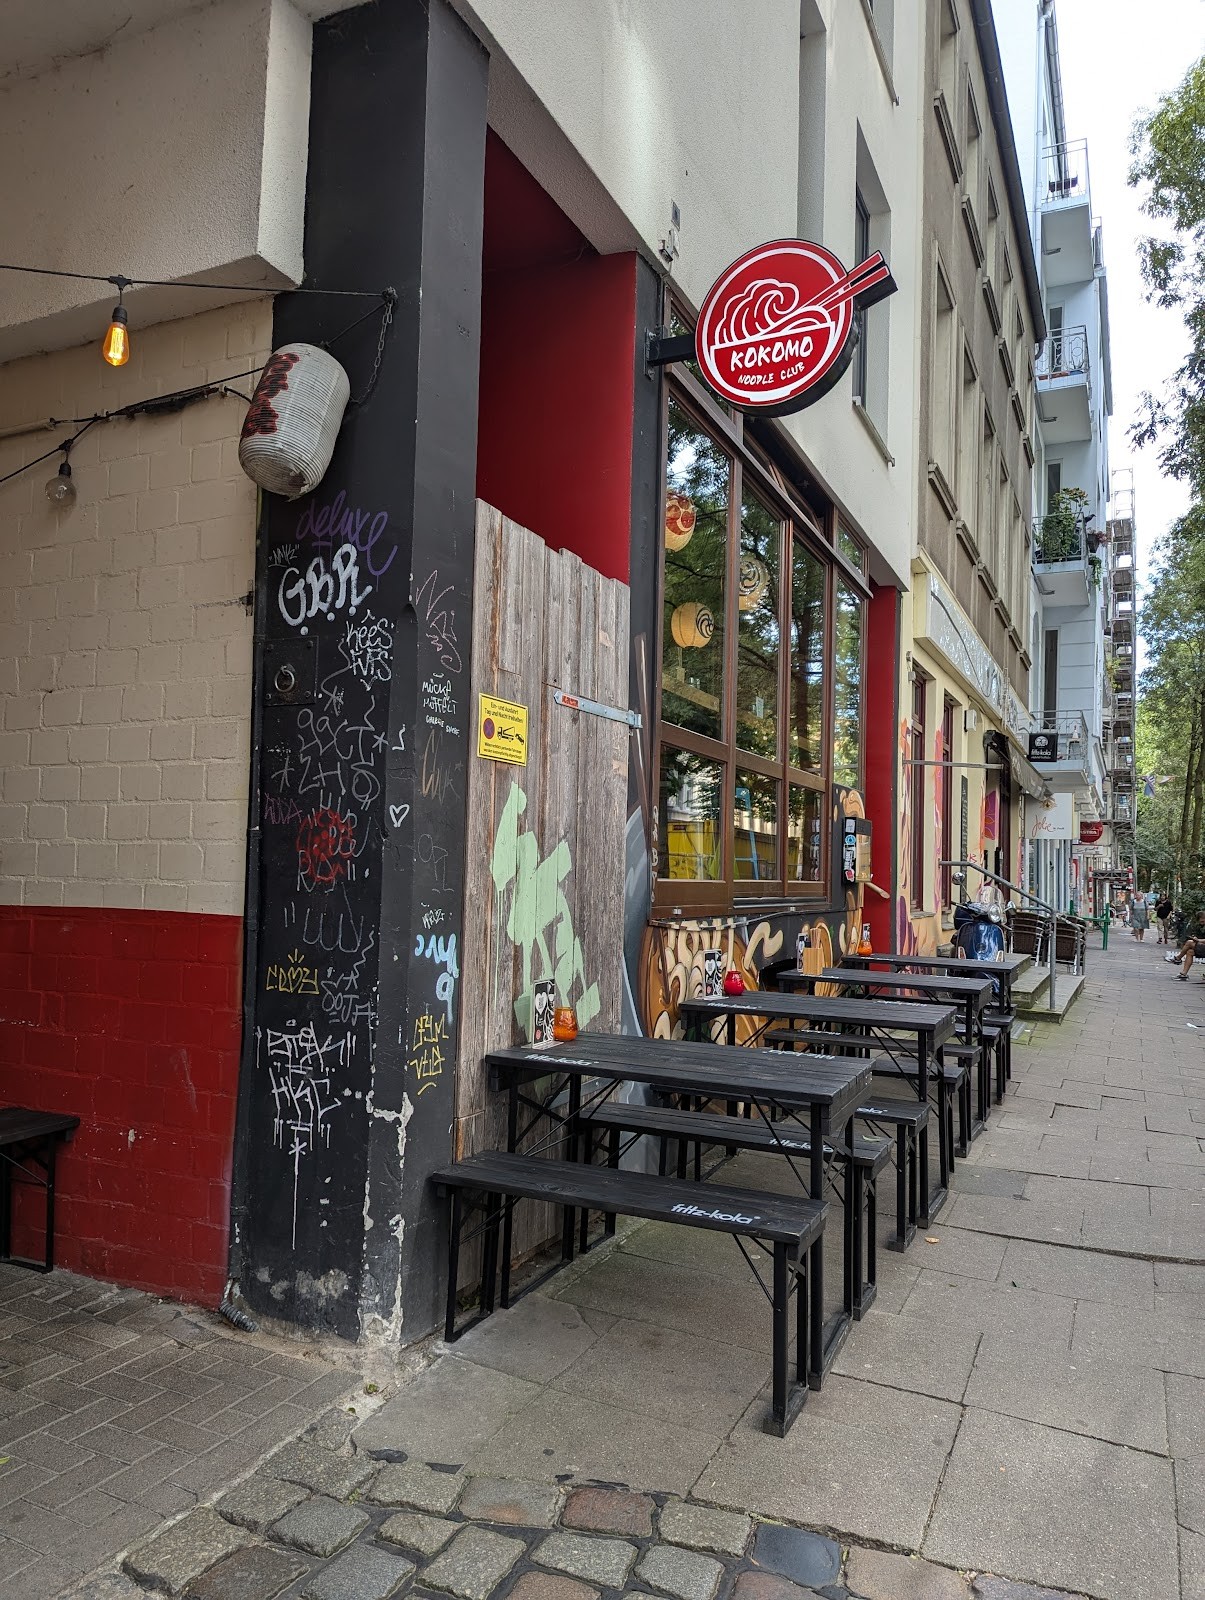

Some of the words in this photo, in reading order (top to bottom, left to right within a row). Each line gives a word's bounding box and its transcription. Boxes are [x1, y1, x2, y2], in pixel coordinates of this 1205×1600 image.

[730, 335, 814, 372] KOKOMO
[737, 373, 775, 386] NOODLE
[780, 361, 805, 381] CLUB
[670, 1203, 753, 1225] fritz-kola
